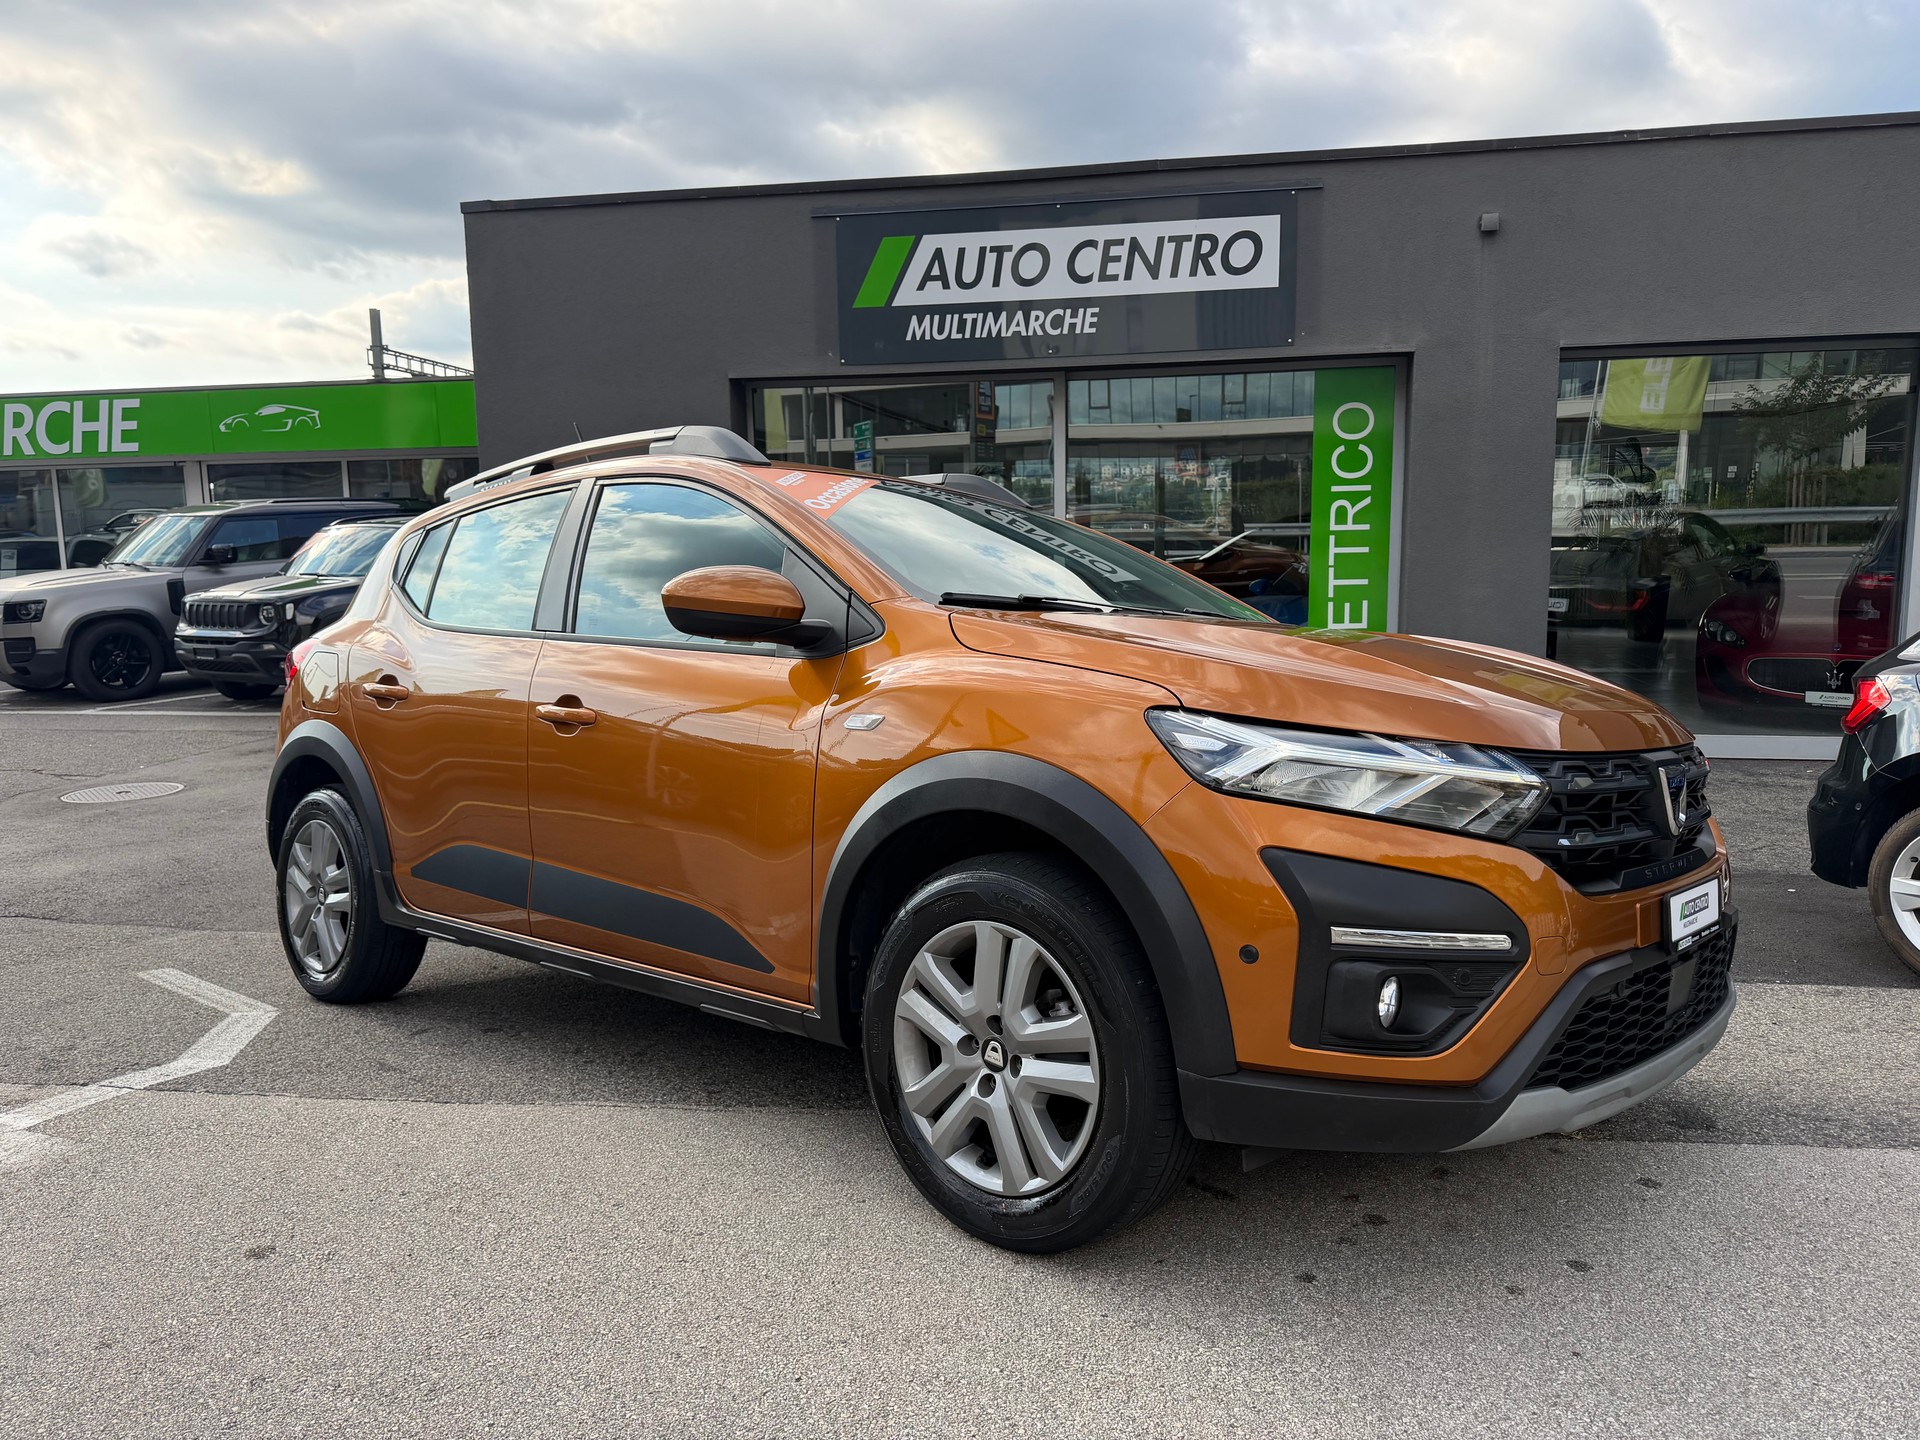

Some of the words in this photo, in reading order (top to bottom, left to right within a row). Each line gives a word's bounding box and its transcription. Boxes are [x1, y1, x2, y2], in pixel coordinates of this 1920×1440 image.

[916, 242, 1051, 291] AUTO
[1067, 230, 1263, 284] CENTRO
[906, 307, 1100, 341] MULTIMARCHE
[3, 398, 140, 456] RCHE
[1327, 401, 1375, 630] ETTRICO
